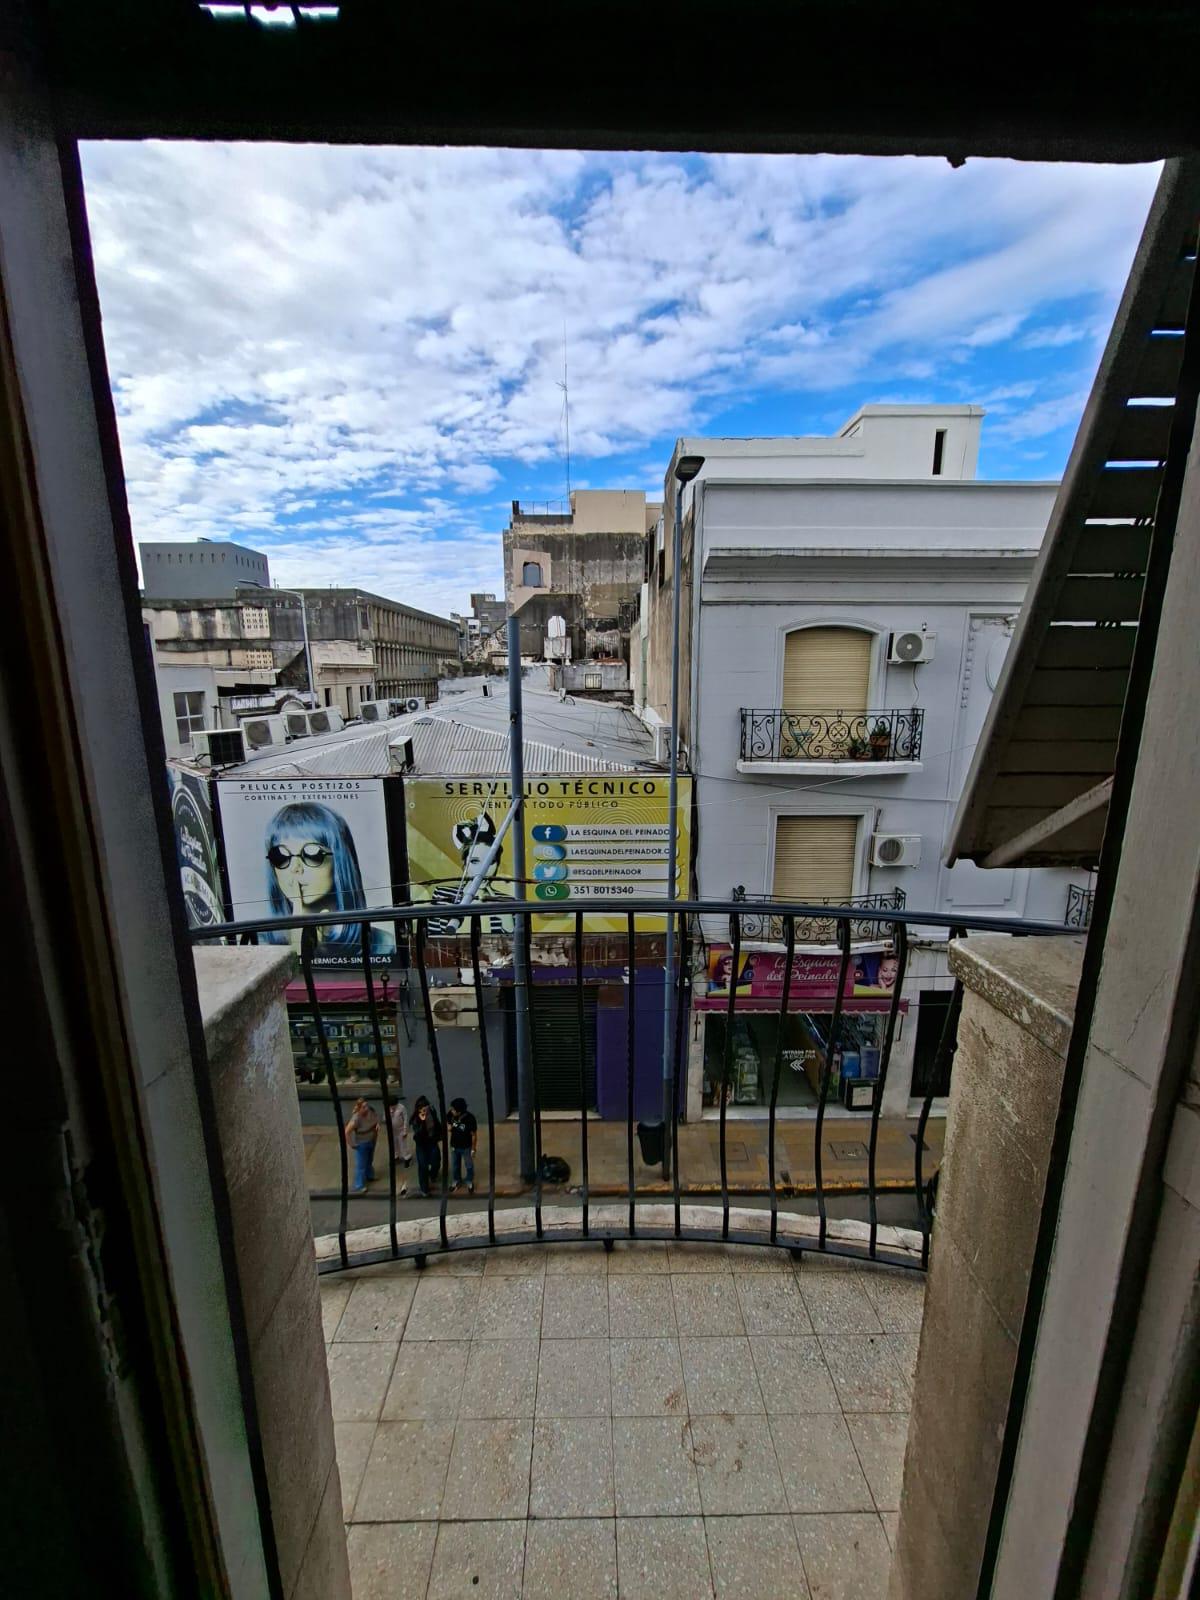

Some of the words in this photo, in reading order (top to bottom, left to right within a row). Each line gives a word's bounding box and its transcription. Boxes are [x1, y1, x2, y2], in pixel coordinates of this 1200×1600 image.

[240, 783, 293, 791] PELUCAS
[302, 782, 360, 790] POSTIZOS
[445, 782, 549, 795] SERVIIO
[560, 780, 656, 795] TÉCNICO
[479, 801, 517, 809] VENT
[533, 801, 565, 809] TODO
[635, 828, 670, 836] PEINADO
[571, 848, 670, 856] LAESQUINADELPEINADOR.C
[574, 886, 590, 895] 351
[593, 886, 634, 895] 8015340
